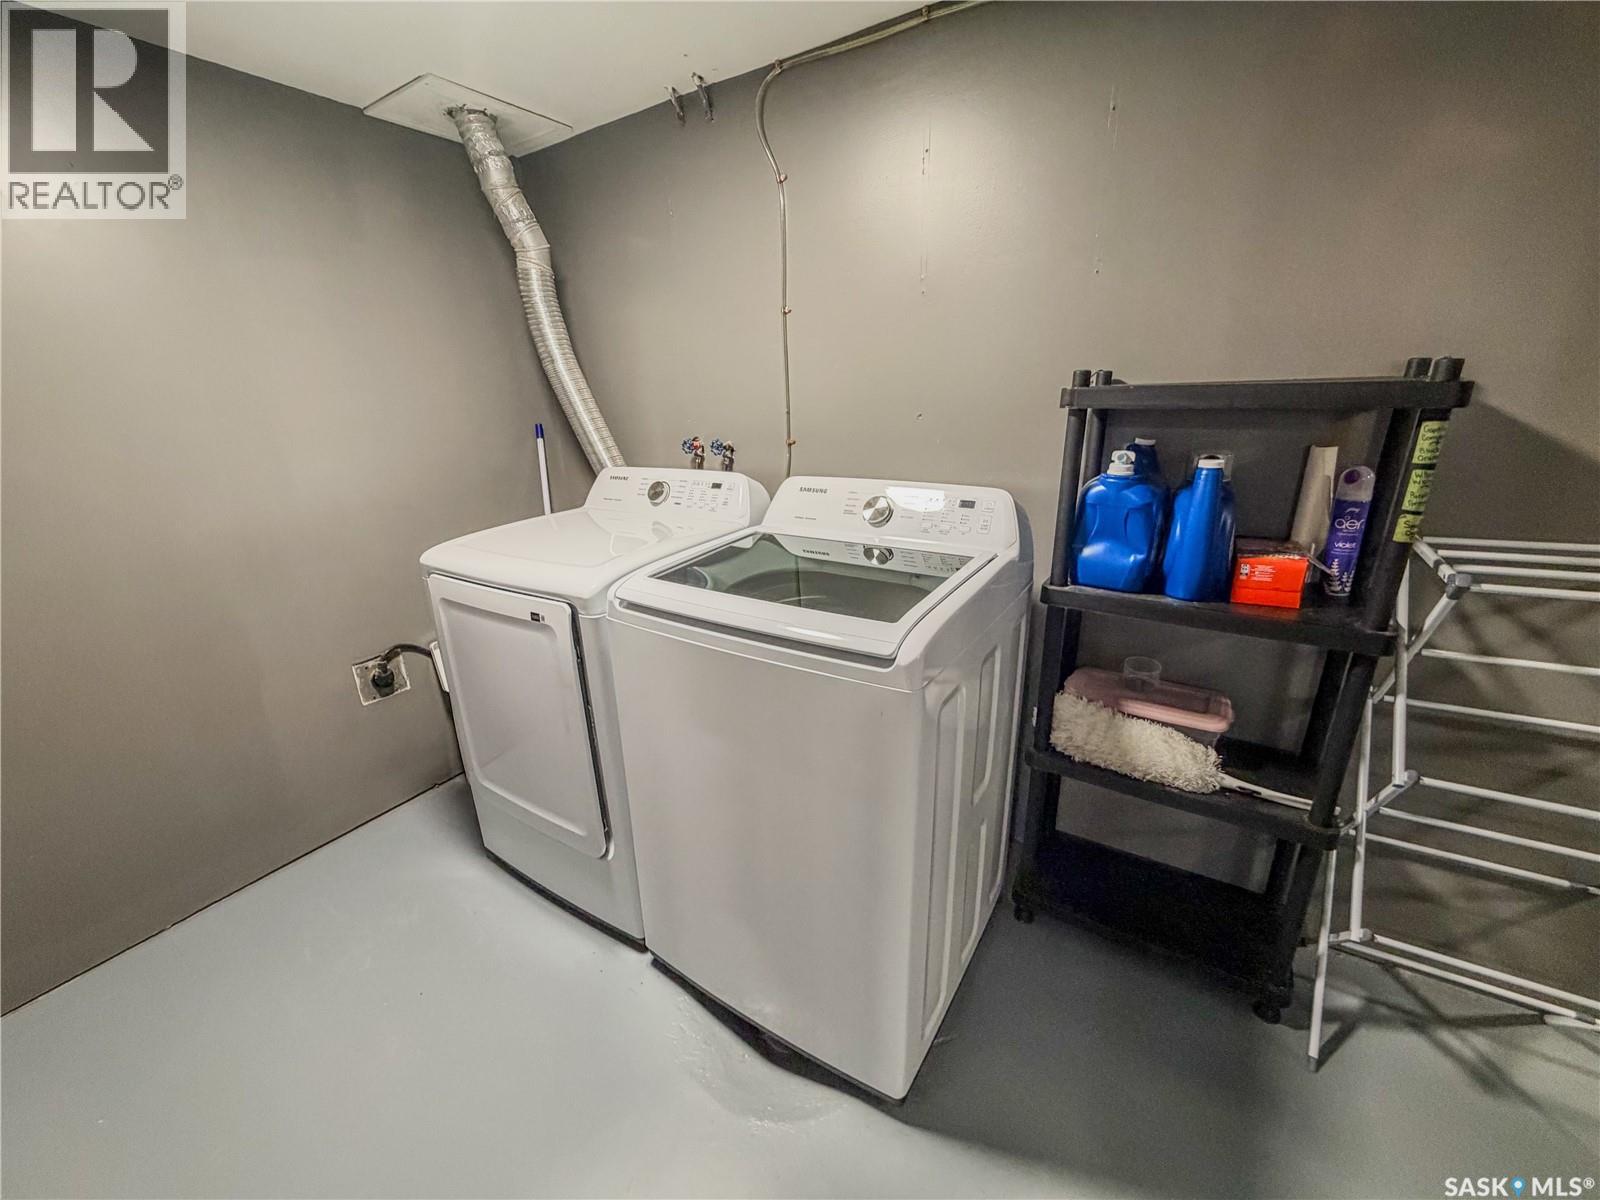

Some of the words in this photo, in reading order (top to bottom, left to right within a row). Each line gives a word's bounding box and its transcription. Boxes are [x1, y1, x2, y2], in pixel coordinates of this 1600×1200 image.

[799, 486, 828, 494] SAMSUNG
[1334, 516, 1365, 530] aer
[1334, 541, 1357, 549] violet
